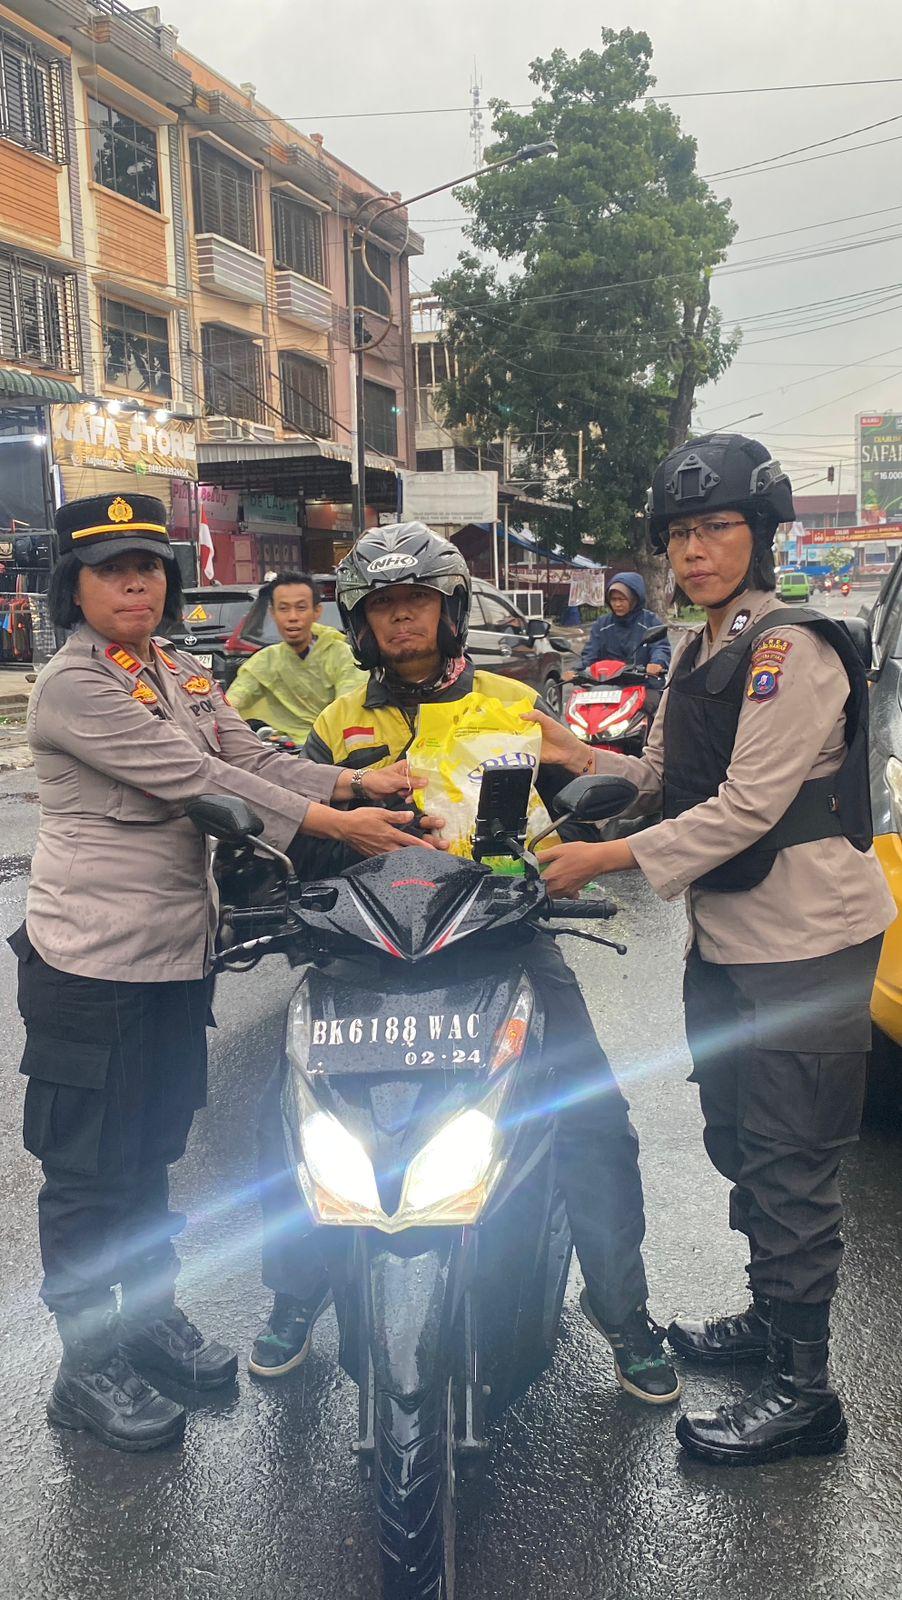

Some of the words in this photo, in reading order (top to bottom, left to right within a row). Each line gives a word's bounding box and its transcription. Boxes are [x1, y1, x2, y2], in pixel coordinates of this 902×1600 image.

[54, 407, 121, 450] KAFA
[128, 413, 197, 461] STORE
[861, 444, 902, 462] SAFA
[428, 1013, 480, 1041] WAC
